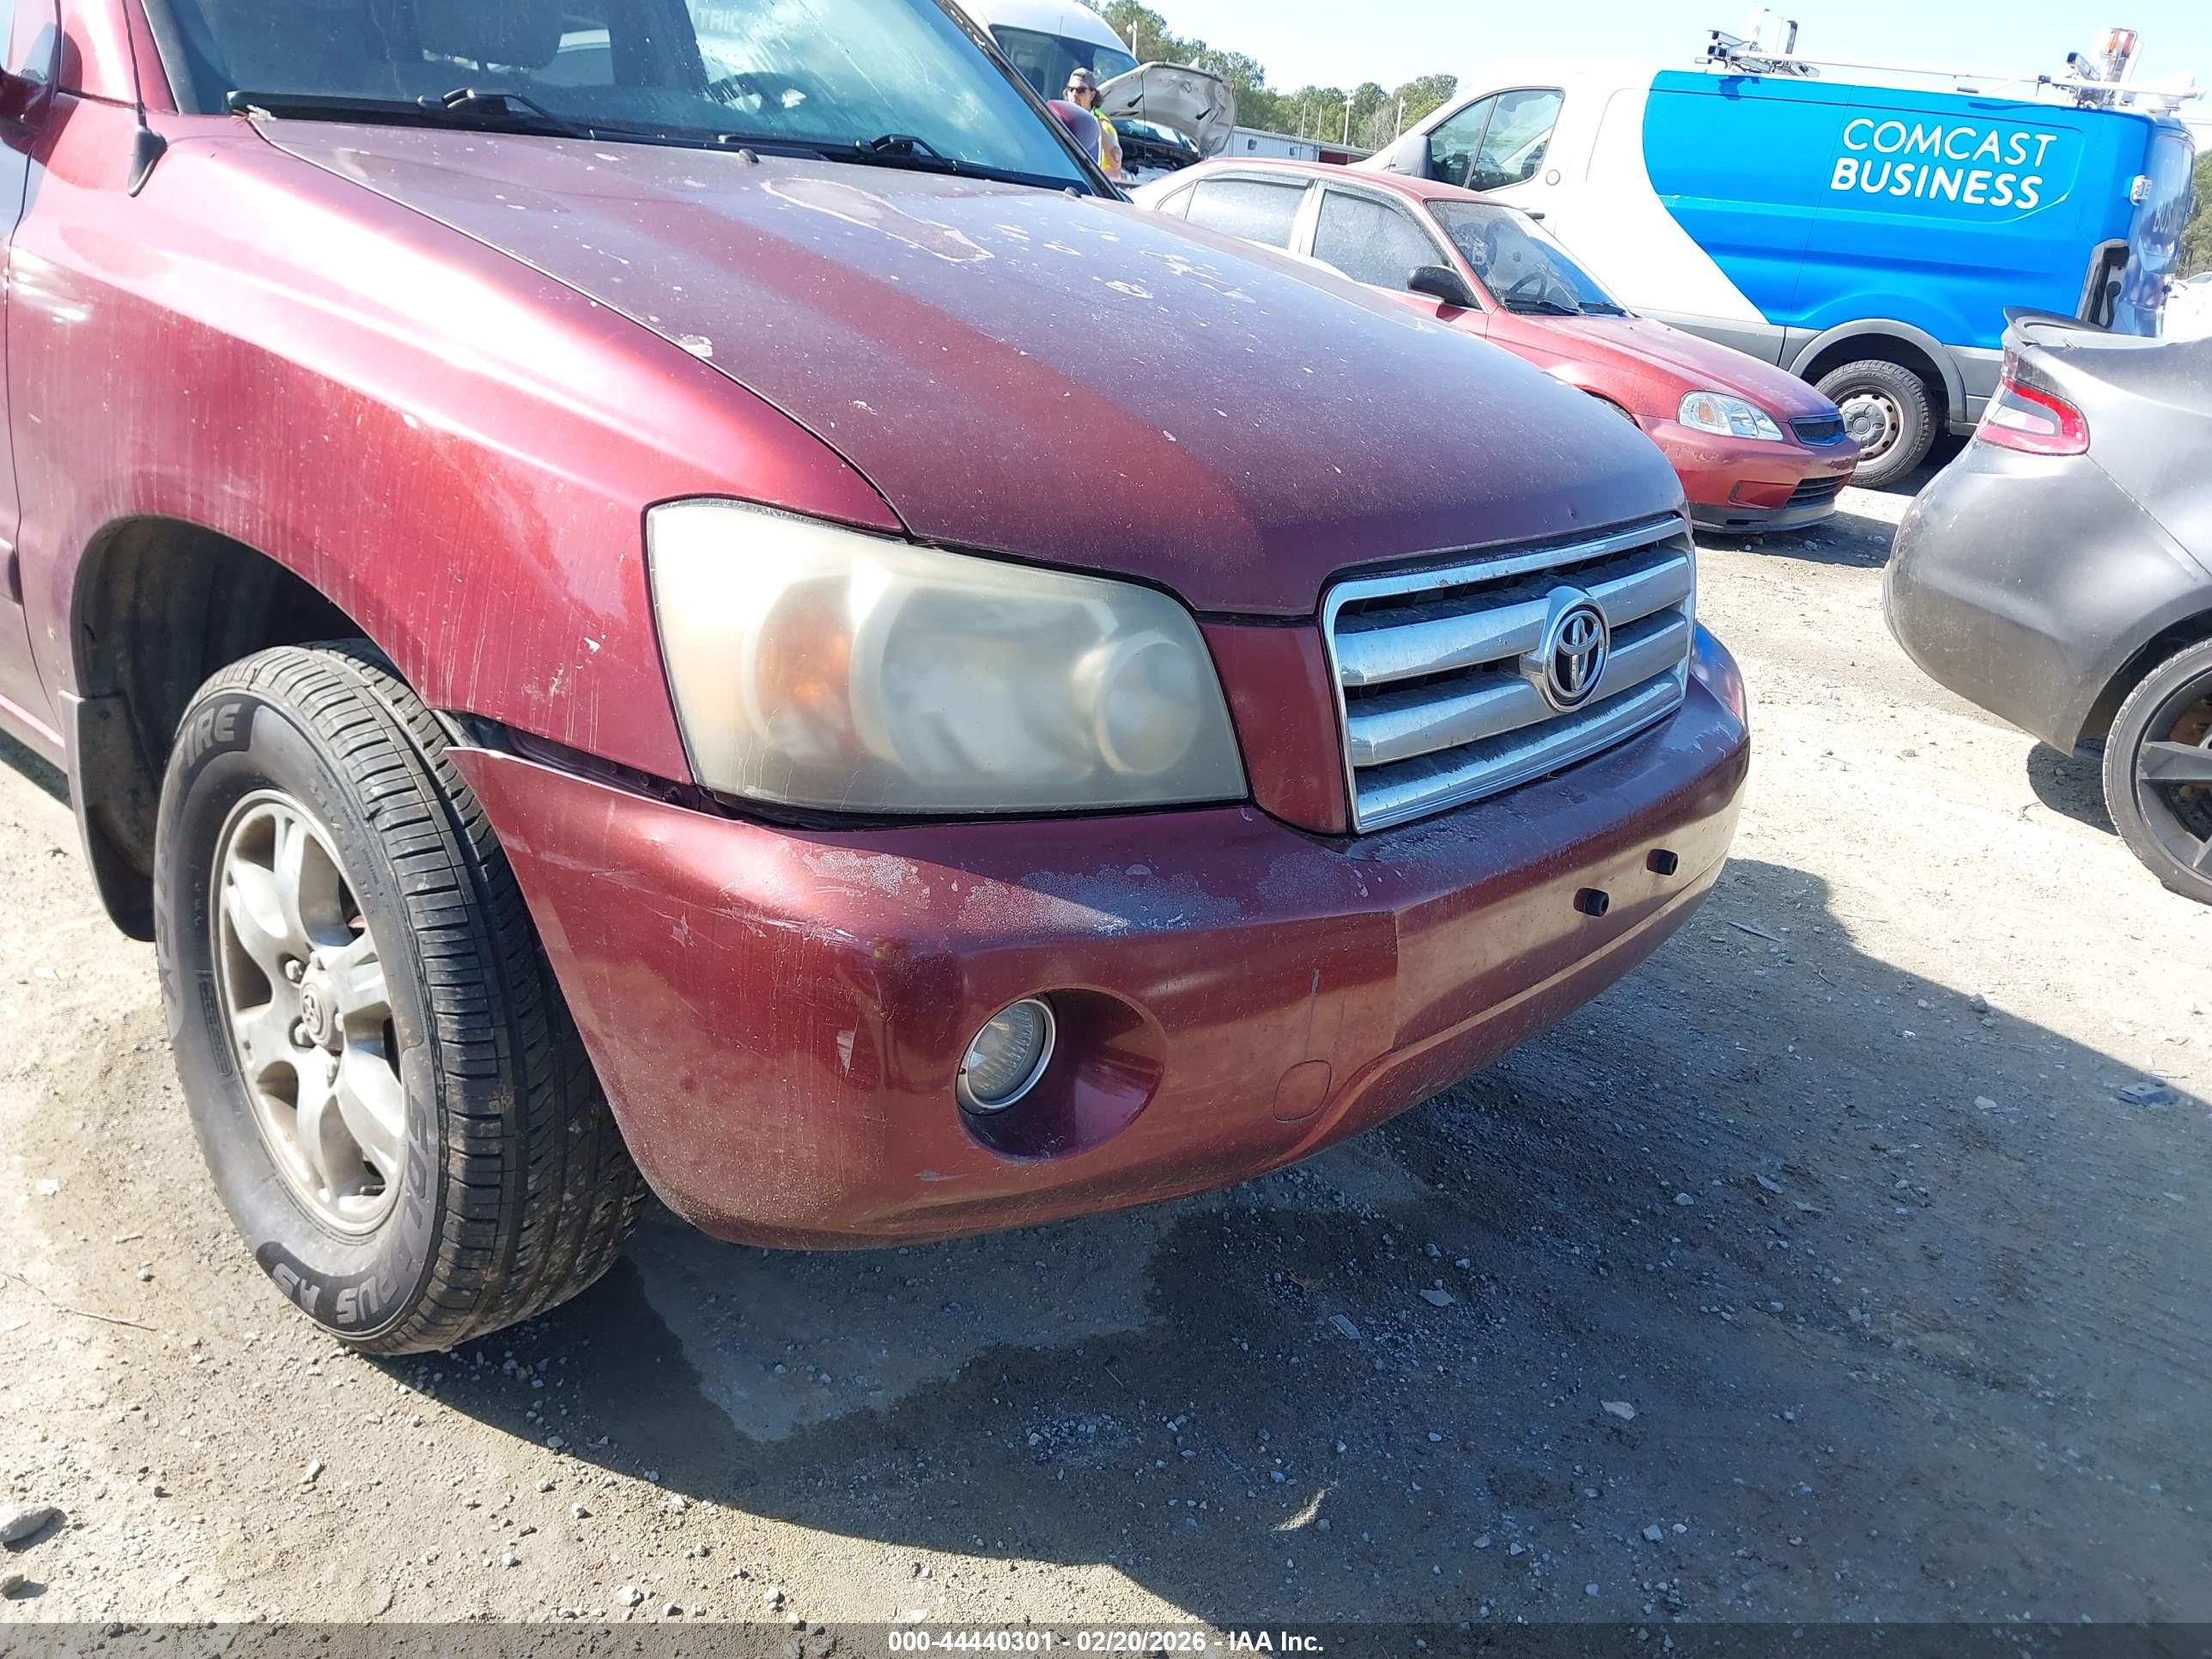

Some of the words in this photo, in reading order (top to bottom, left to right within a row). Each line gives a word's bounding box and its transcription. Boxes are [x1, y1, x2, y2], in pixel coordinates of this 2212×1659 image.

[1843, 118, 2057, 167] COMCAST
[1830, 157, 2043, 210] BUSINESS
[156, 702, 241, 959] STIRE
